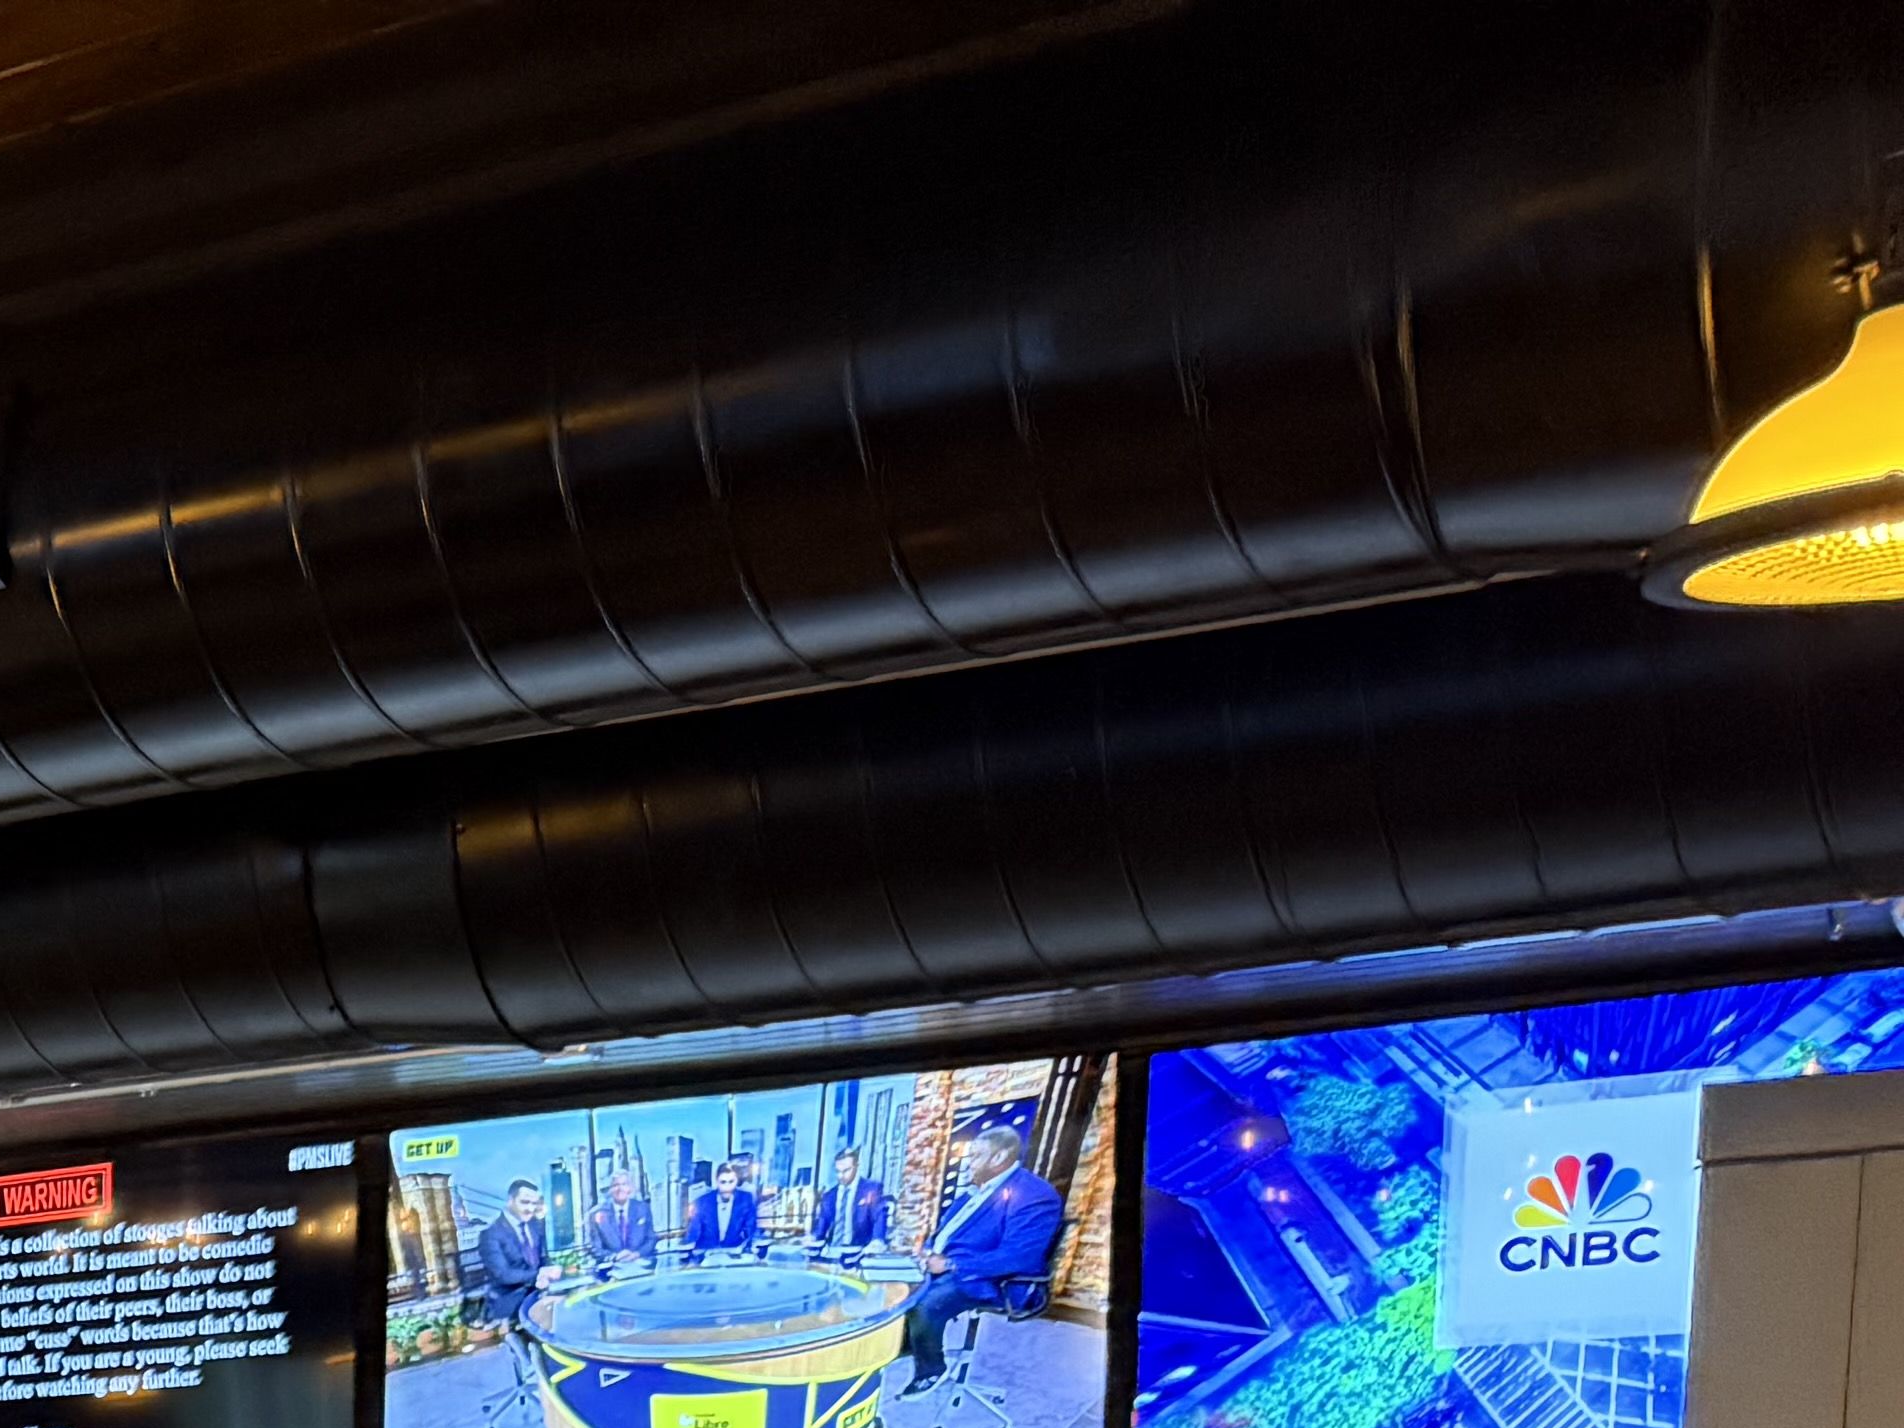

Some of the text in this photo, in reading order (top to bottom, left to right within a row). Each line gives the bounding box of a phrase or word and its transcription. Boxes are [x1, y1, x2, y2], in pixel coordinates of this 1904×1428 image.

[406, 1140, 454, 1158] GET UP
[3, 1176, 98, 1215] WARNING
[11, 1237, 23, 1250] a
[24, 1226, 103, 1250] collection
[103, 1221, 126, 1245] of
[124, 1219, 185, 1243] stooges
[186, 1209, 247, 1235] talking
[247, 1206, 298, 1230] about
[1499, 1226, 1661, 1272] CNBC
[20, 1253, 71, 1278] world.
[73, 1251, 87, 1271] It
[89, 1250, 104, 1271] is
[106, 1250, 157, 1270] meant
[158, 1246, 176, 1264] to
[178, 1242, 199, 1262] be
[201, 1233, 275, 1259] comedic
[36, 1272, 115, 1302] expressed
[116, 1275, 137, 1292] on
[139, 1267, 172, 1290] this
[172, 1265, 218, 1288] show
[219, 1261, 243, 1283] do
[244, 1258, 278, 1281] not
[1, 1303, 54, 1329] beliefs
[55, 1301, 77, 1323] of
[76, 1298, 114, 1322] their
[114, 1297, 164, 1322] peers,
[165, 1289, 205, 1313] their
[206, 1287, 251, 1310] boss,
[251, 1286, 277, 1306] or
[80, 1321, 130, 1346] words
[132, 1320, 196, 1342] because
[246, 1309, 290, 1332] how
[8, 1353, 43, 1376] talk.
[44, 1350, 65, 1374] If
[61, 1353, 95, 1376] you
[94, 1351, 122, 1370] are
[122, 1350, 136, 1367] a
[193, 1339, 249, 1366] please
[249, 1332, 293, 1357] seek
[35, 1373, 109, 1399] watching
[109, 1374, 141, 1395] any
[142, 1366, 204, 1391] further.
